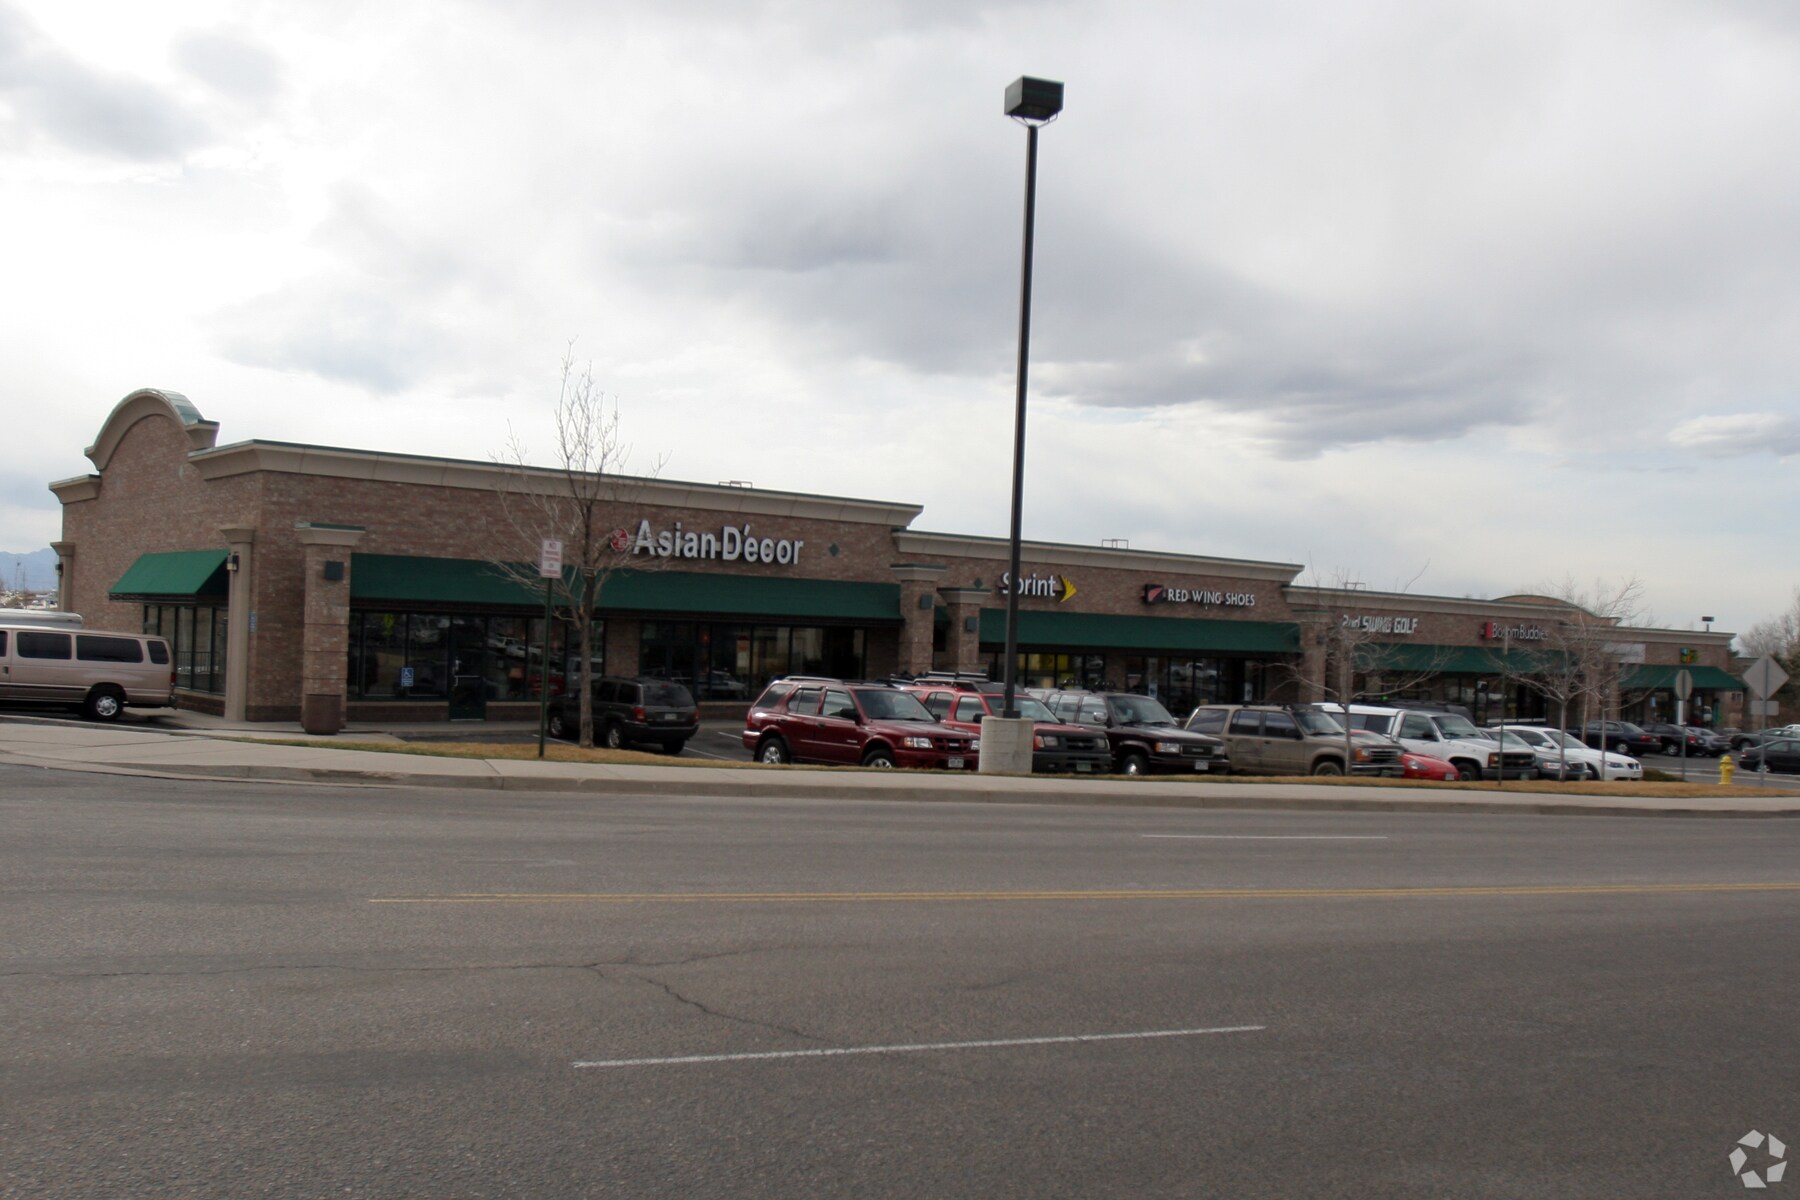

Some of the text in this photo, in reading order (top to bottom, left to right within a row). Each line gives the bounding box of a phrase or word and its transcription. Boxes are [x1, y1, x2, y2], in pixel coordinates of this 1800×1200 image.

[633, 519, 716, 559] Asian
[1168, 588, 1255, 606] RED WING SHOES
[1362, 616, 1392, 633] SWING
[1393, 617, 1418, 633] GOLF
